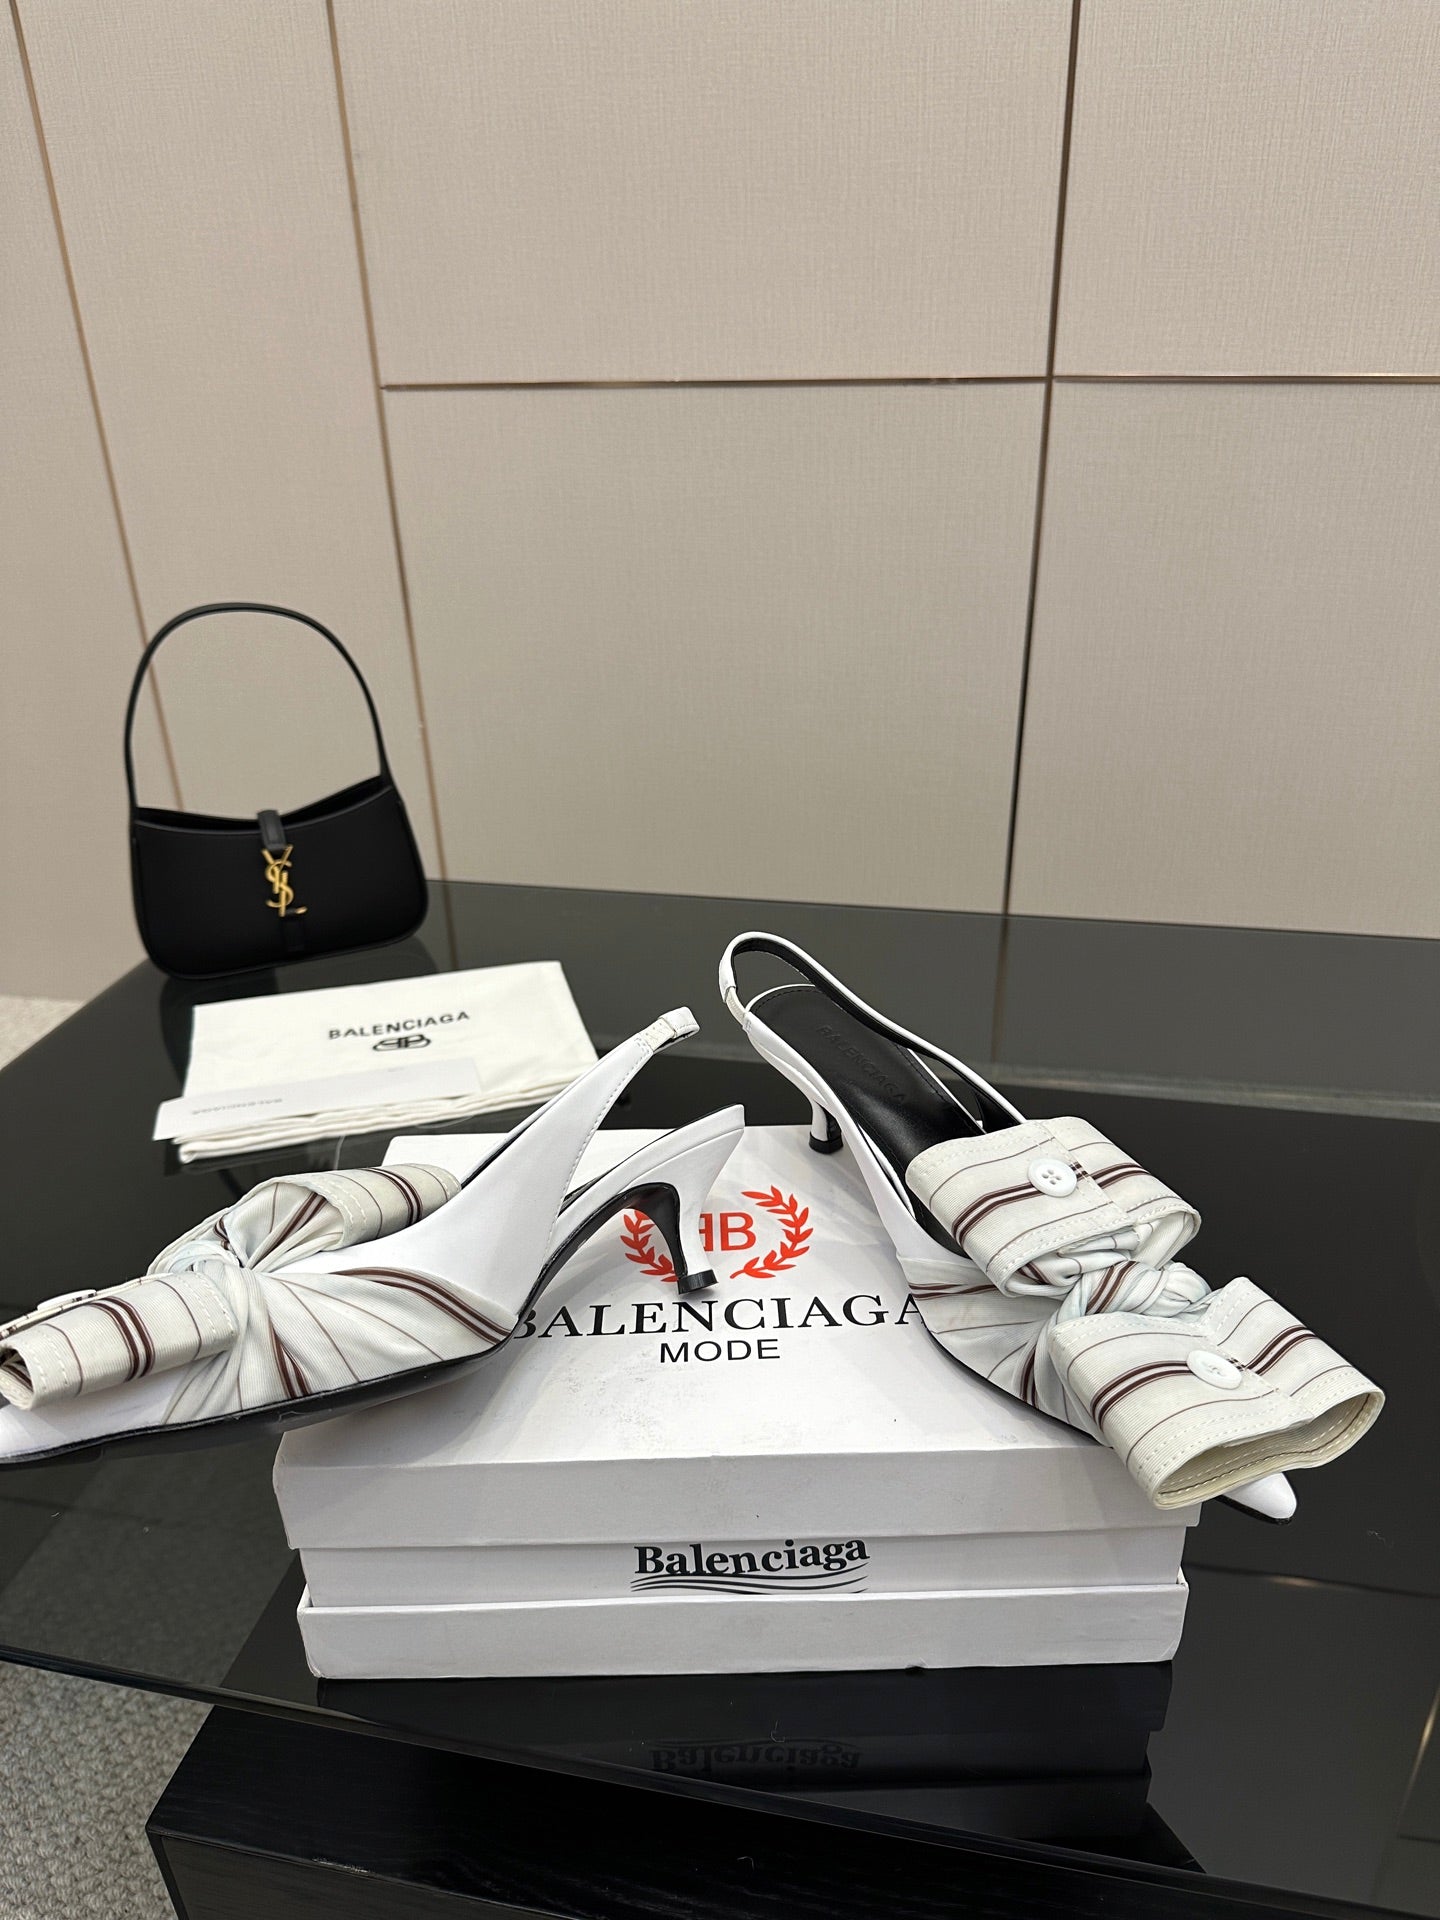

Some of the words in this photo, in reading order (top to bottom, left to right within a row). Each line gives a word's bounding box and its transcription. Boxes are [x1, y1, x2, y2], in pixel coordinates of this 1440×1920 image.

[328, 1011, 470, 1039] BALENCIAGA
[660, 1339, 781, 1363] MODE
[634, 1538, 870, 1575] Balenciaga
